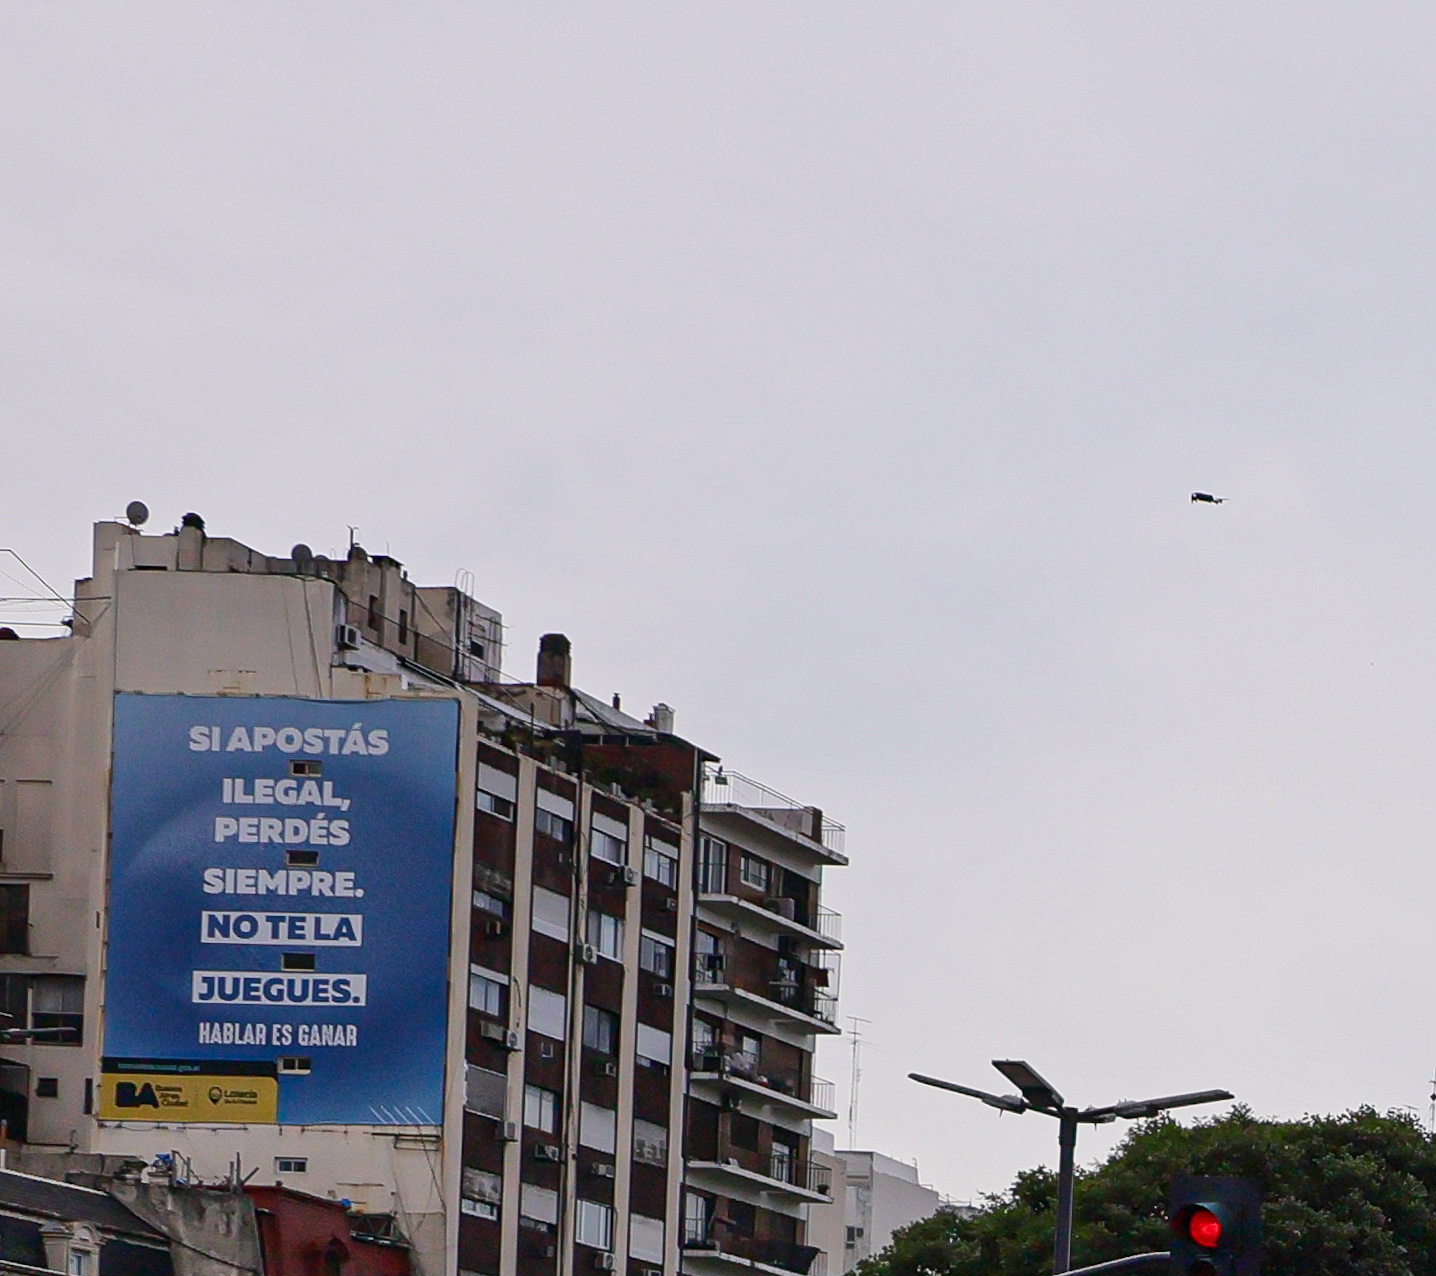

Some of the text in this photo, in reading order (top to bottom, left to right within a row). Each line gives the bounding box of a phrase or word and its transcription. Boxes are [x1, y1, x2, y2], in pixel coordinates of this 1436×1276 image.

[188, 722, 389, 756] SI APOSTÁS
[222, 777, 351, 812] ILEGAL,
[214, 812, 350, 846] PERDÉS
[202, 867, 365, 898] SIEMPRE.
[207, 914, 357, 942] NO TE LA
[198, 976, 361, 1004] JUEGUES.
[198, 1022, 358, 1047] HABLAR ES GANAR
